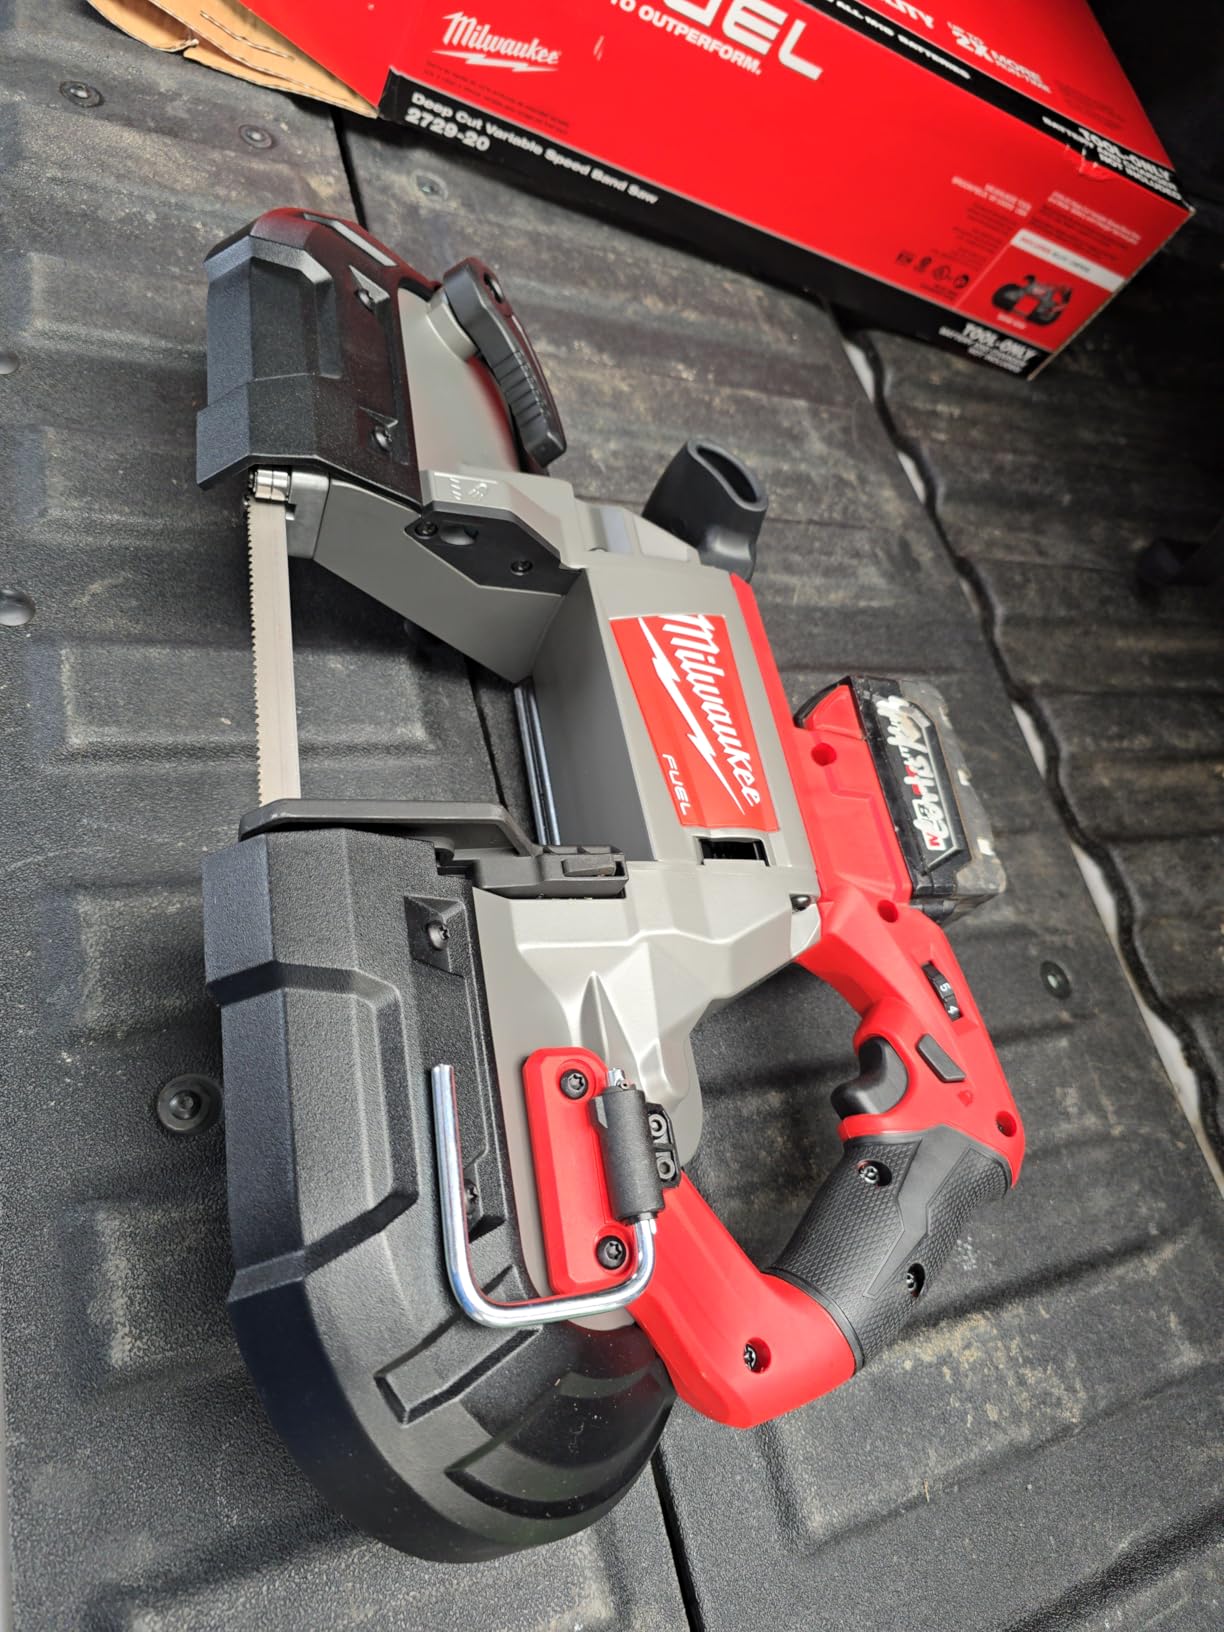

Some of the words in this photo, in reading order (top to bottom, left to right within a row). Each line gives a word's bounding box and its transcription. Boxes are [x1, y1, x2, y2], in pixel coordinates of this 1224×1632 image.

[442, 11, 560, 64] Milwaukee
[638, 5, 762, 75] OUTPERFORM.
[404, 106, 491, 151] 2729-20
[411, 92, 453, 118] Deep
[455, 110, 483, 131] Cut
[485, 121, 543, 155] Variable
[544, 148, 591, 176] Speed
[590, 167, 628, 192] Band
[627, 183, 658, 204] Saw
[656, 614, 760, 808] Milwaukee
[662, 753, 692, 816] FUEL
[939, 982, 952, 993] 5
